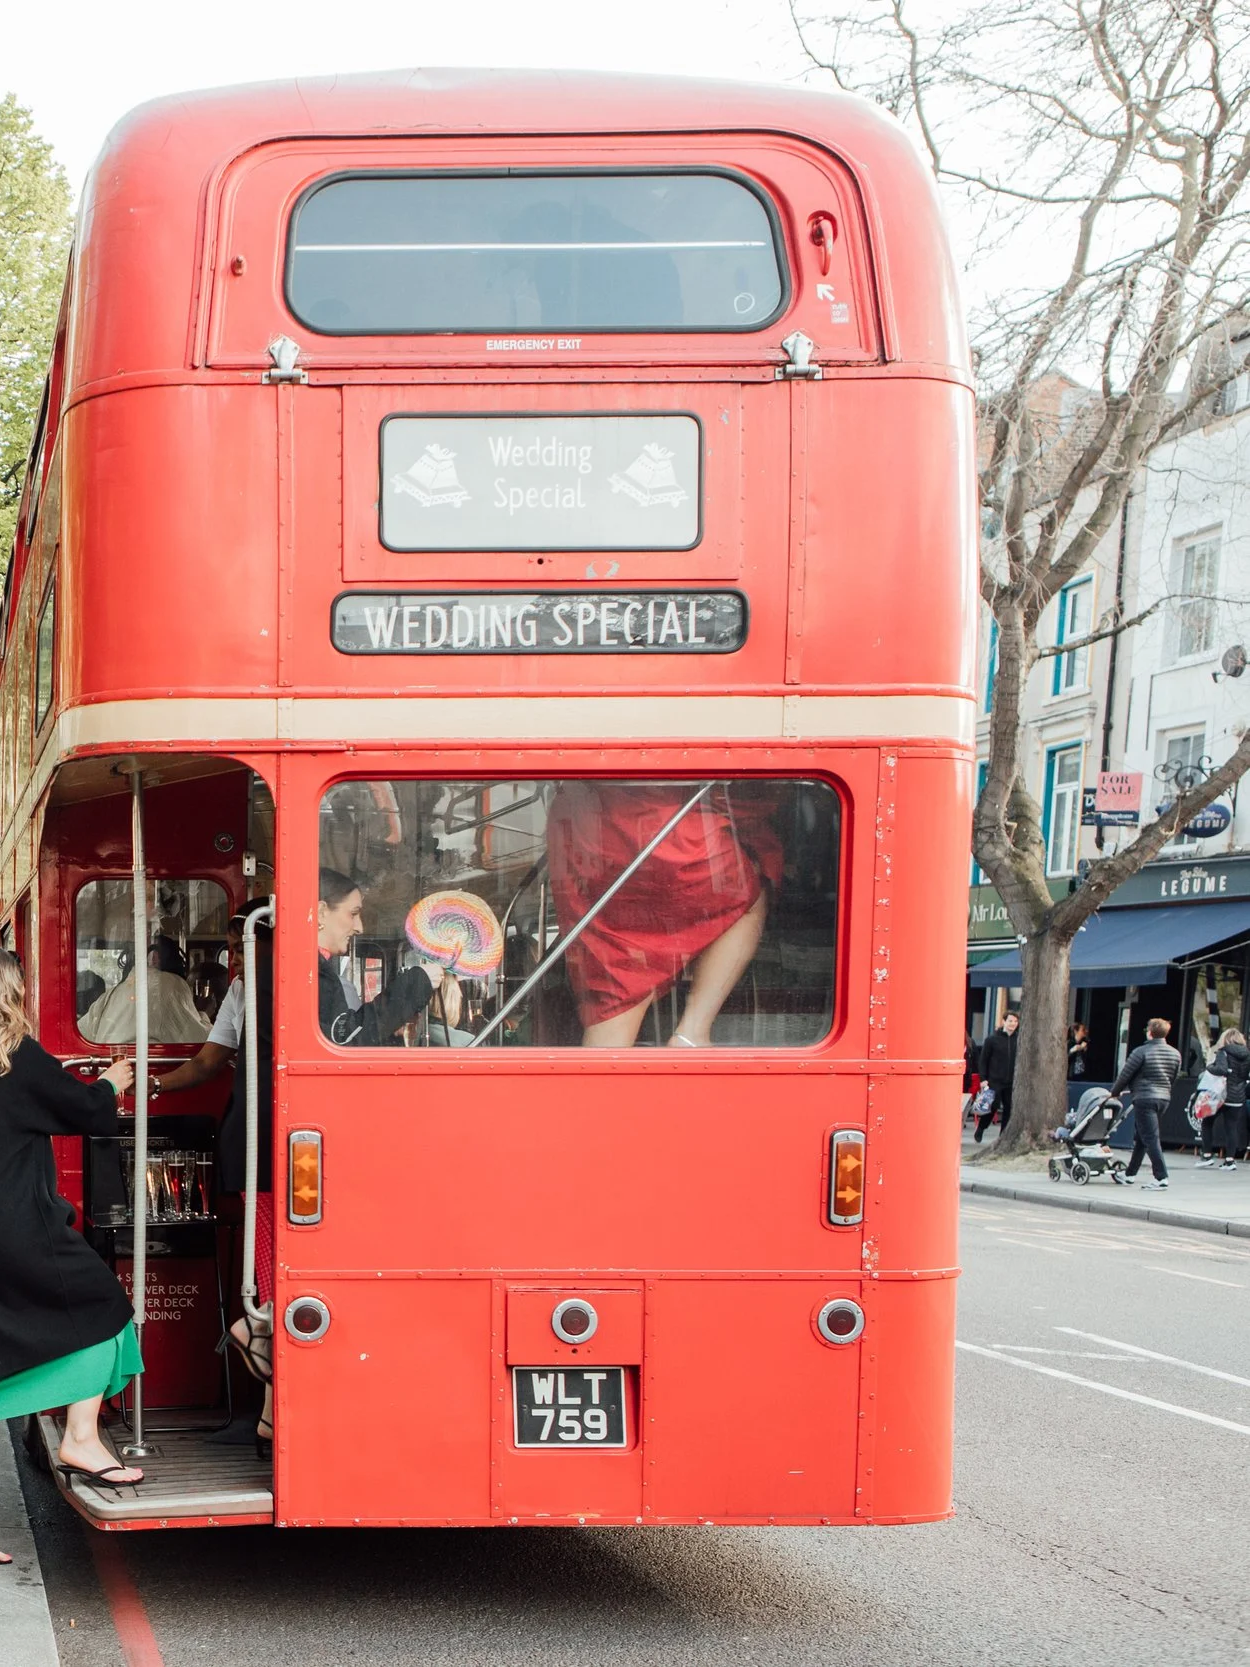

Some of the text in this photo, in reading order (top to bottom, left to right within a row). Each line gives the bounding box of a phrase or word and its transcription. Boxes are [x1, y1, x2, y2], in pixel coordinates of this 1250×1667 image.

[486, 339, 582, 350] EMERGENCY EXIT
[488, 436, 593, 474] Wedding
[493, 477, 586, 516] Special
[364, 601, 707, 649] WEDDING SPECIAL
[1102, 775, 1129, 785] FOR
[1101, 786, 1134, 795] SALE
[1185, 818, 1226, 829] EGUME
[1161, 875, 1227, 897] LEGUME
[125, 1272, 158, 1282] STS
[125, 1285, 199, 1295] LWER DECK
[164, 1298, 195, 1308] DECK
[144, 1311, 182, 1321] NDING
[531, 1372, 607, 1405] WLT
[531, 1408, 608, 1441] 759
